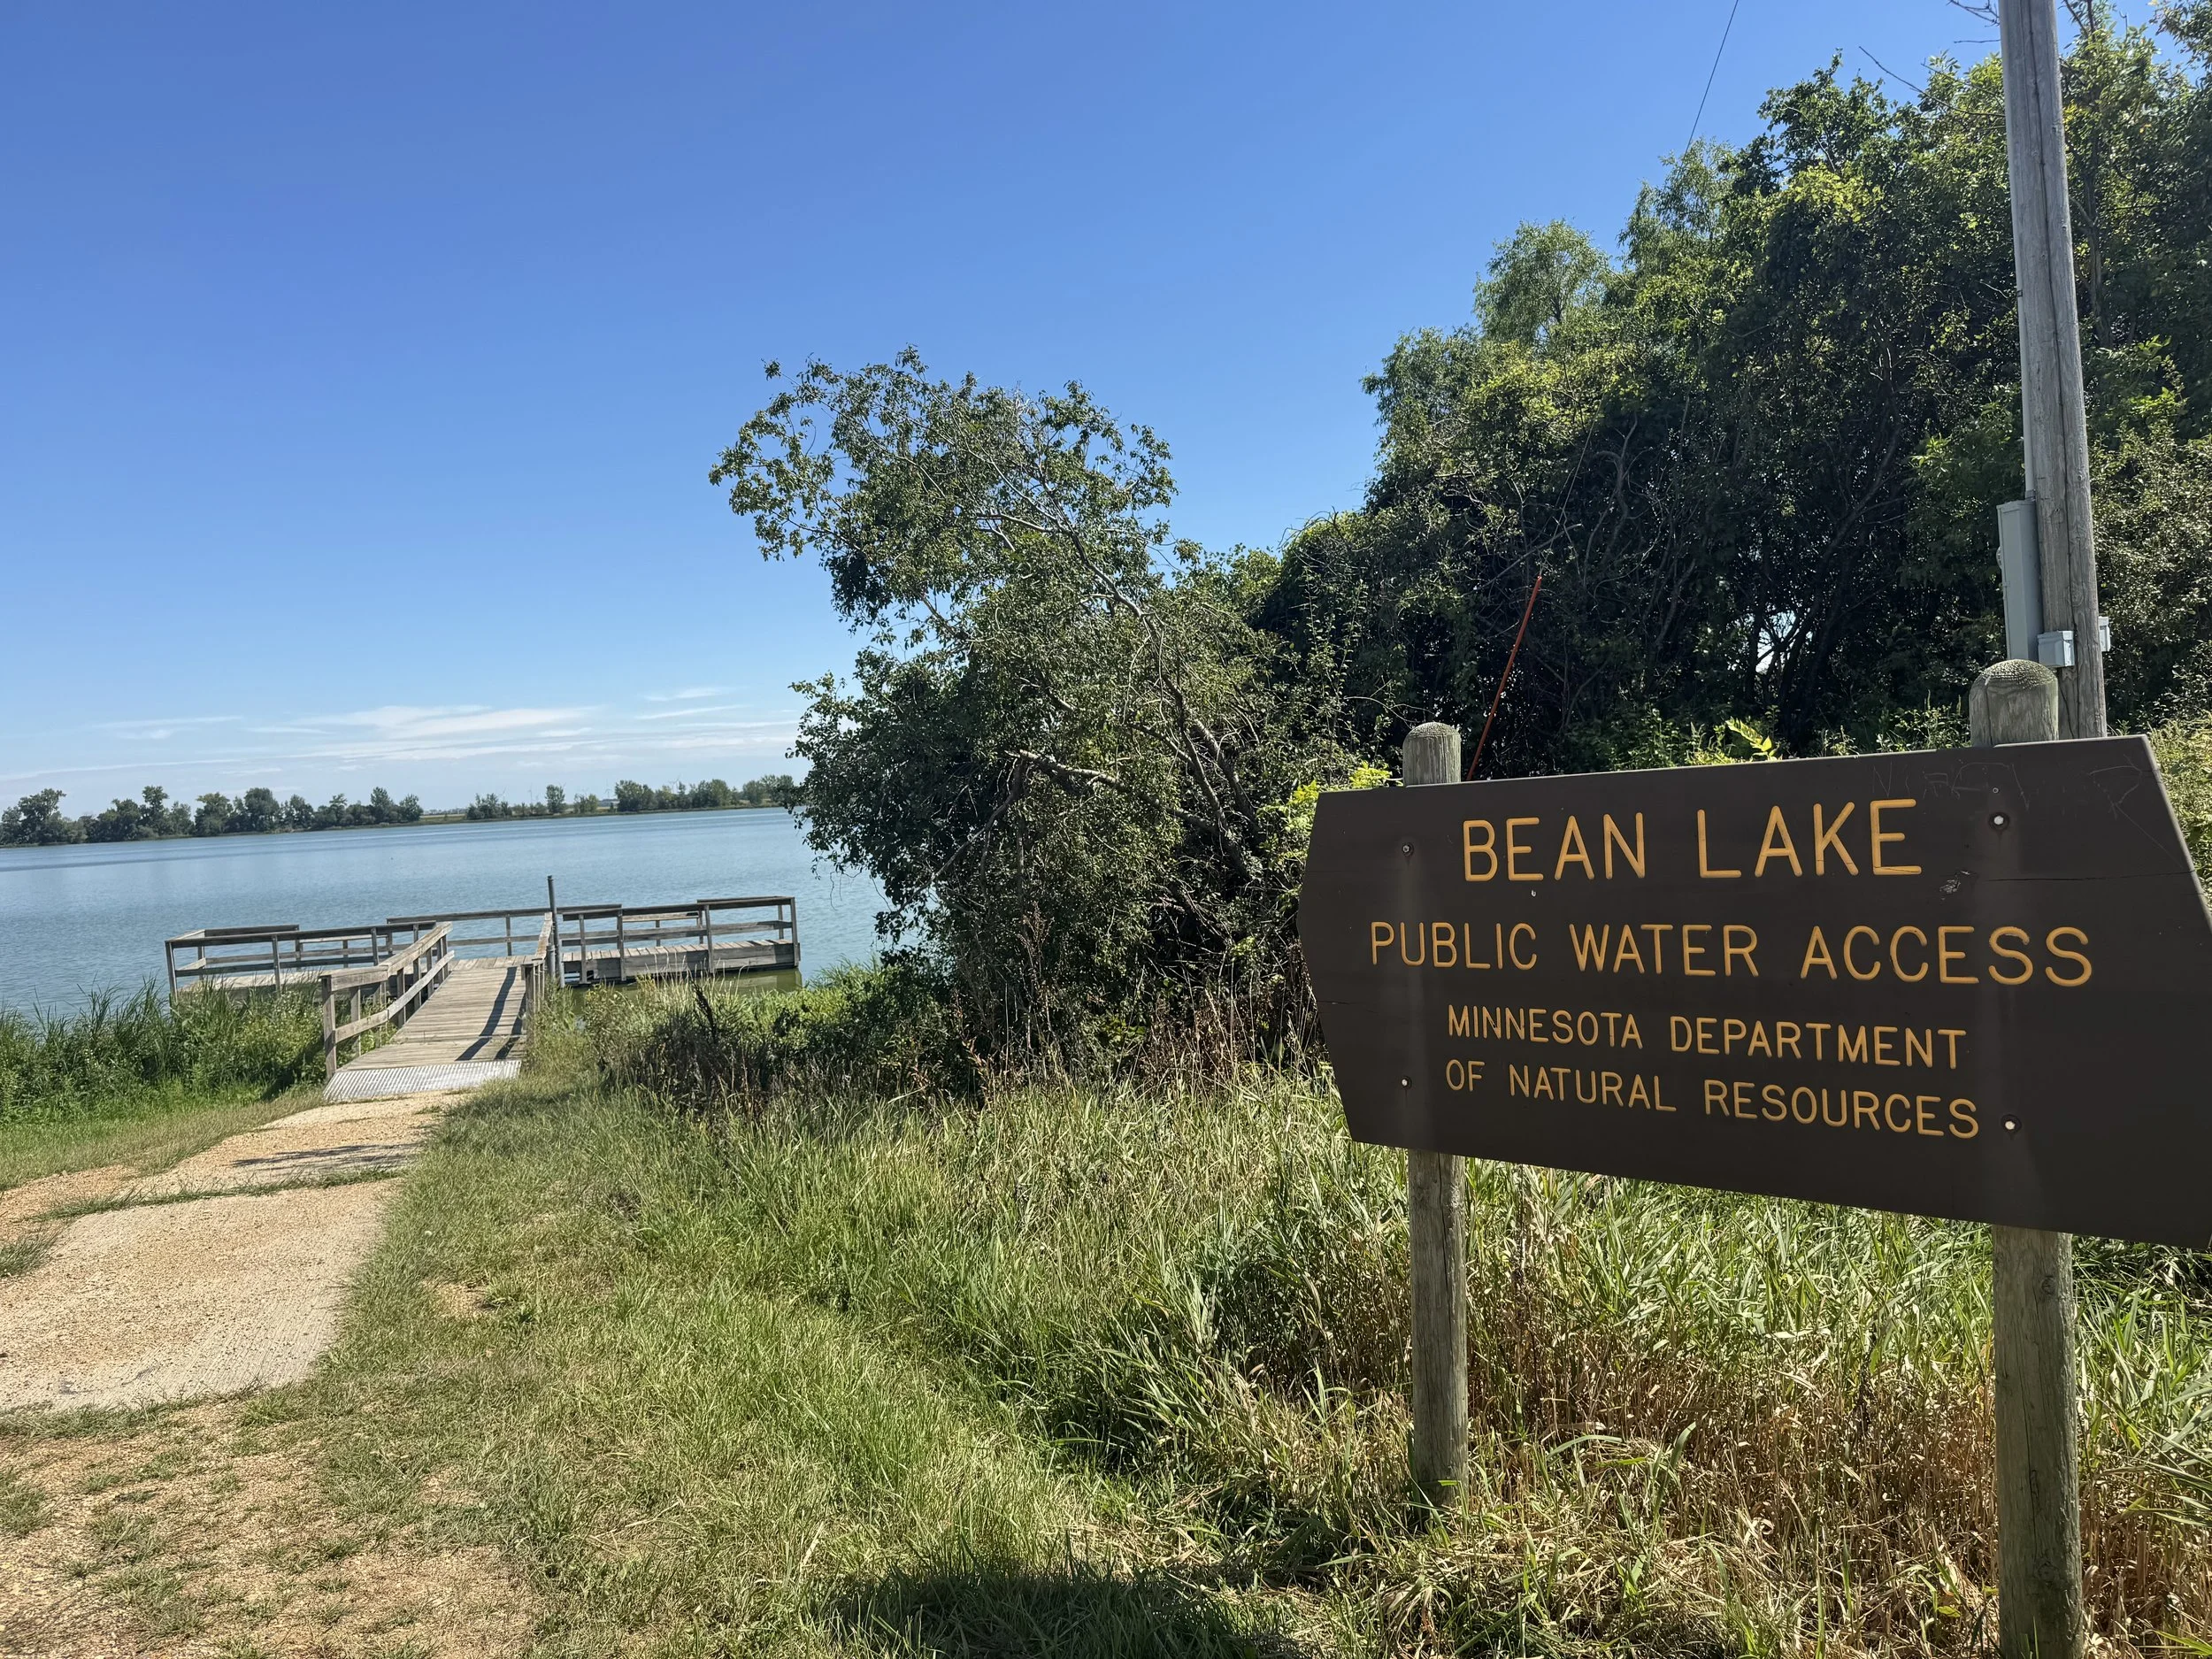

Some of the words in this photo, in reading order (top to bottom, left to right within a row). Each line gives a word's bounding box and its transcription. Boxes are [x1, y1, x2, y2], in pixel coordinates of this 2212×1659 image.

[1463, 813, 1647, 881] BEAN
[1697, 798, 1923, 877] LAKE
[1371, 921, 1538, 970] PUBLIC
[1569, 924, 1759, 977] WATER
[1801, 926, 2093, 987] ACCESS
[1448, 1005, 1642, 1048] MINNESOTA
[1670, 1016, 1967, 1069] DEPARTMENT
[1445, 1060, 1486, 1094] OF
[1509, 1065, 1677, 1111] NATURAL
[1703, 1079, 1979, 1139] RESOURCES
